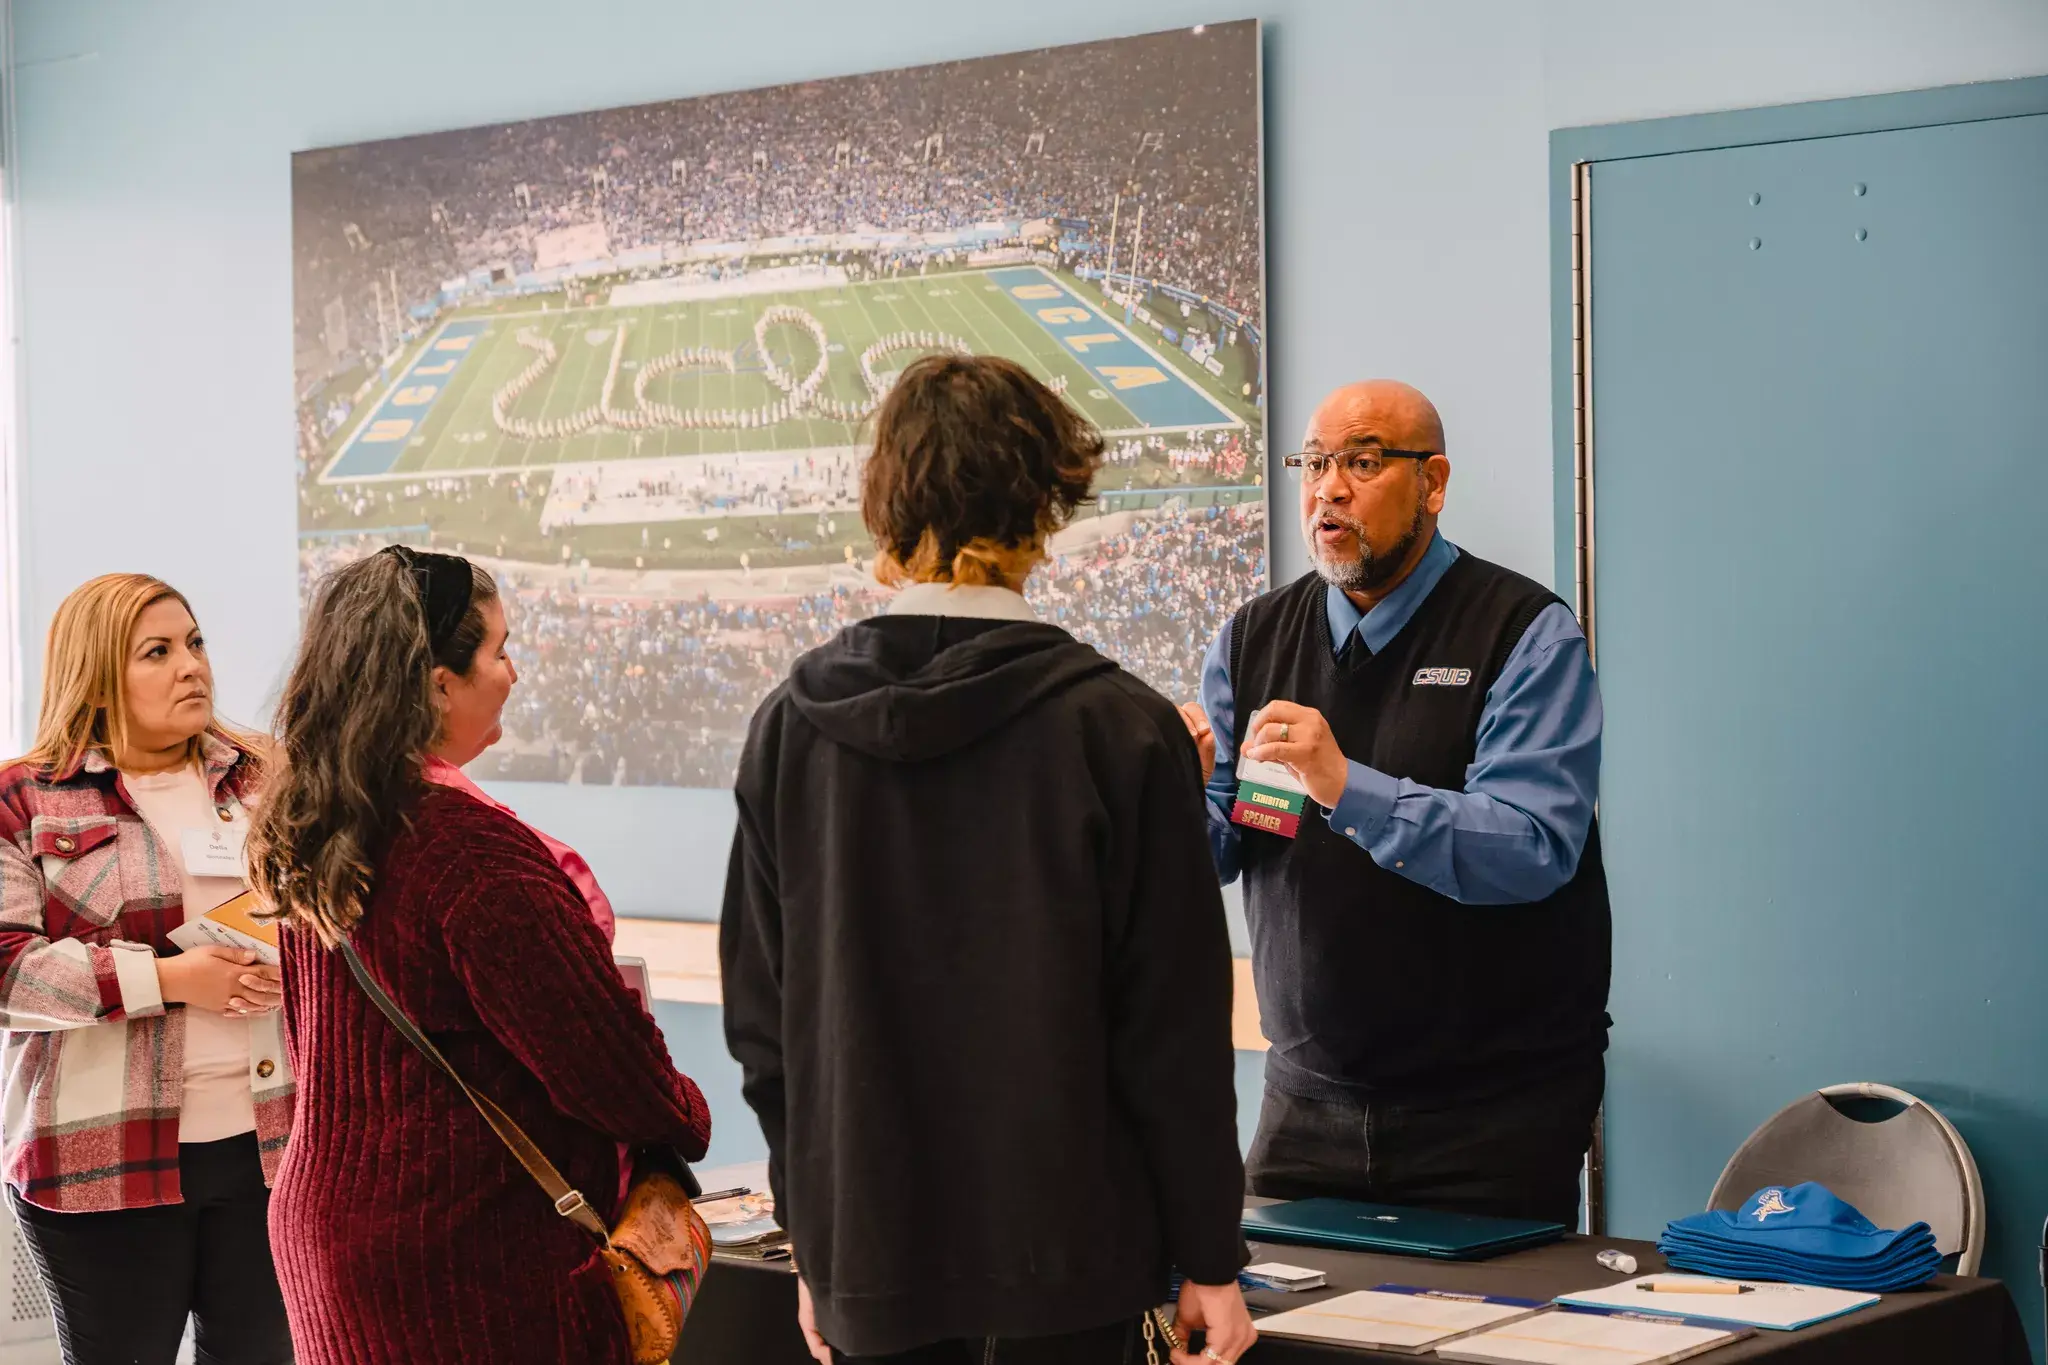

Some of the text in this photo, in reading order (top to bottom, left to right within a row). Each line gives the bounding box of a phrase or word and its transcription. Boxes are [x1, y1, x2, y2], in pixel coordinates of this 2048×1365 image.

[1010, 283, 1170, 390] UCLA
[360, 334, 476, 443] UCLA
[1412, 667, 1472, 686] CSUB
[1251, 791, 1290, 810] EXHIBITOR
[1241, 809, 1282, 831] SPEAKER
